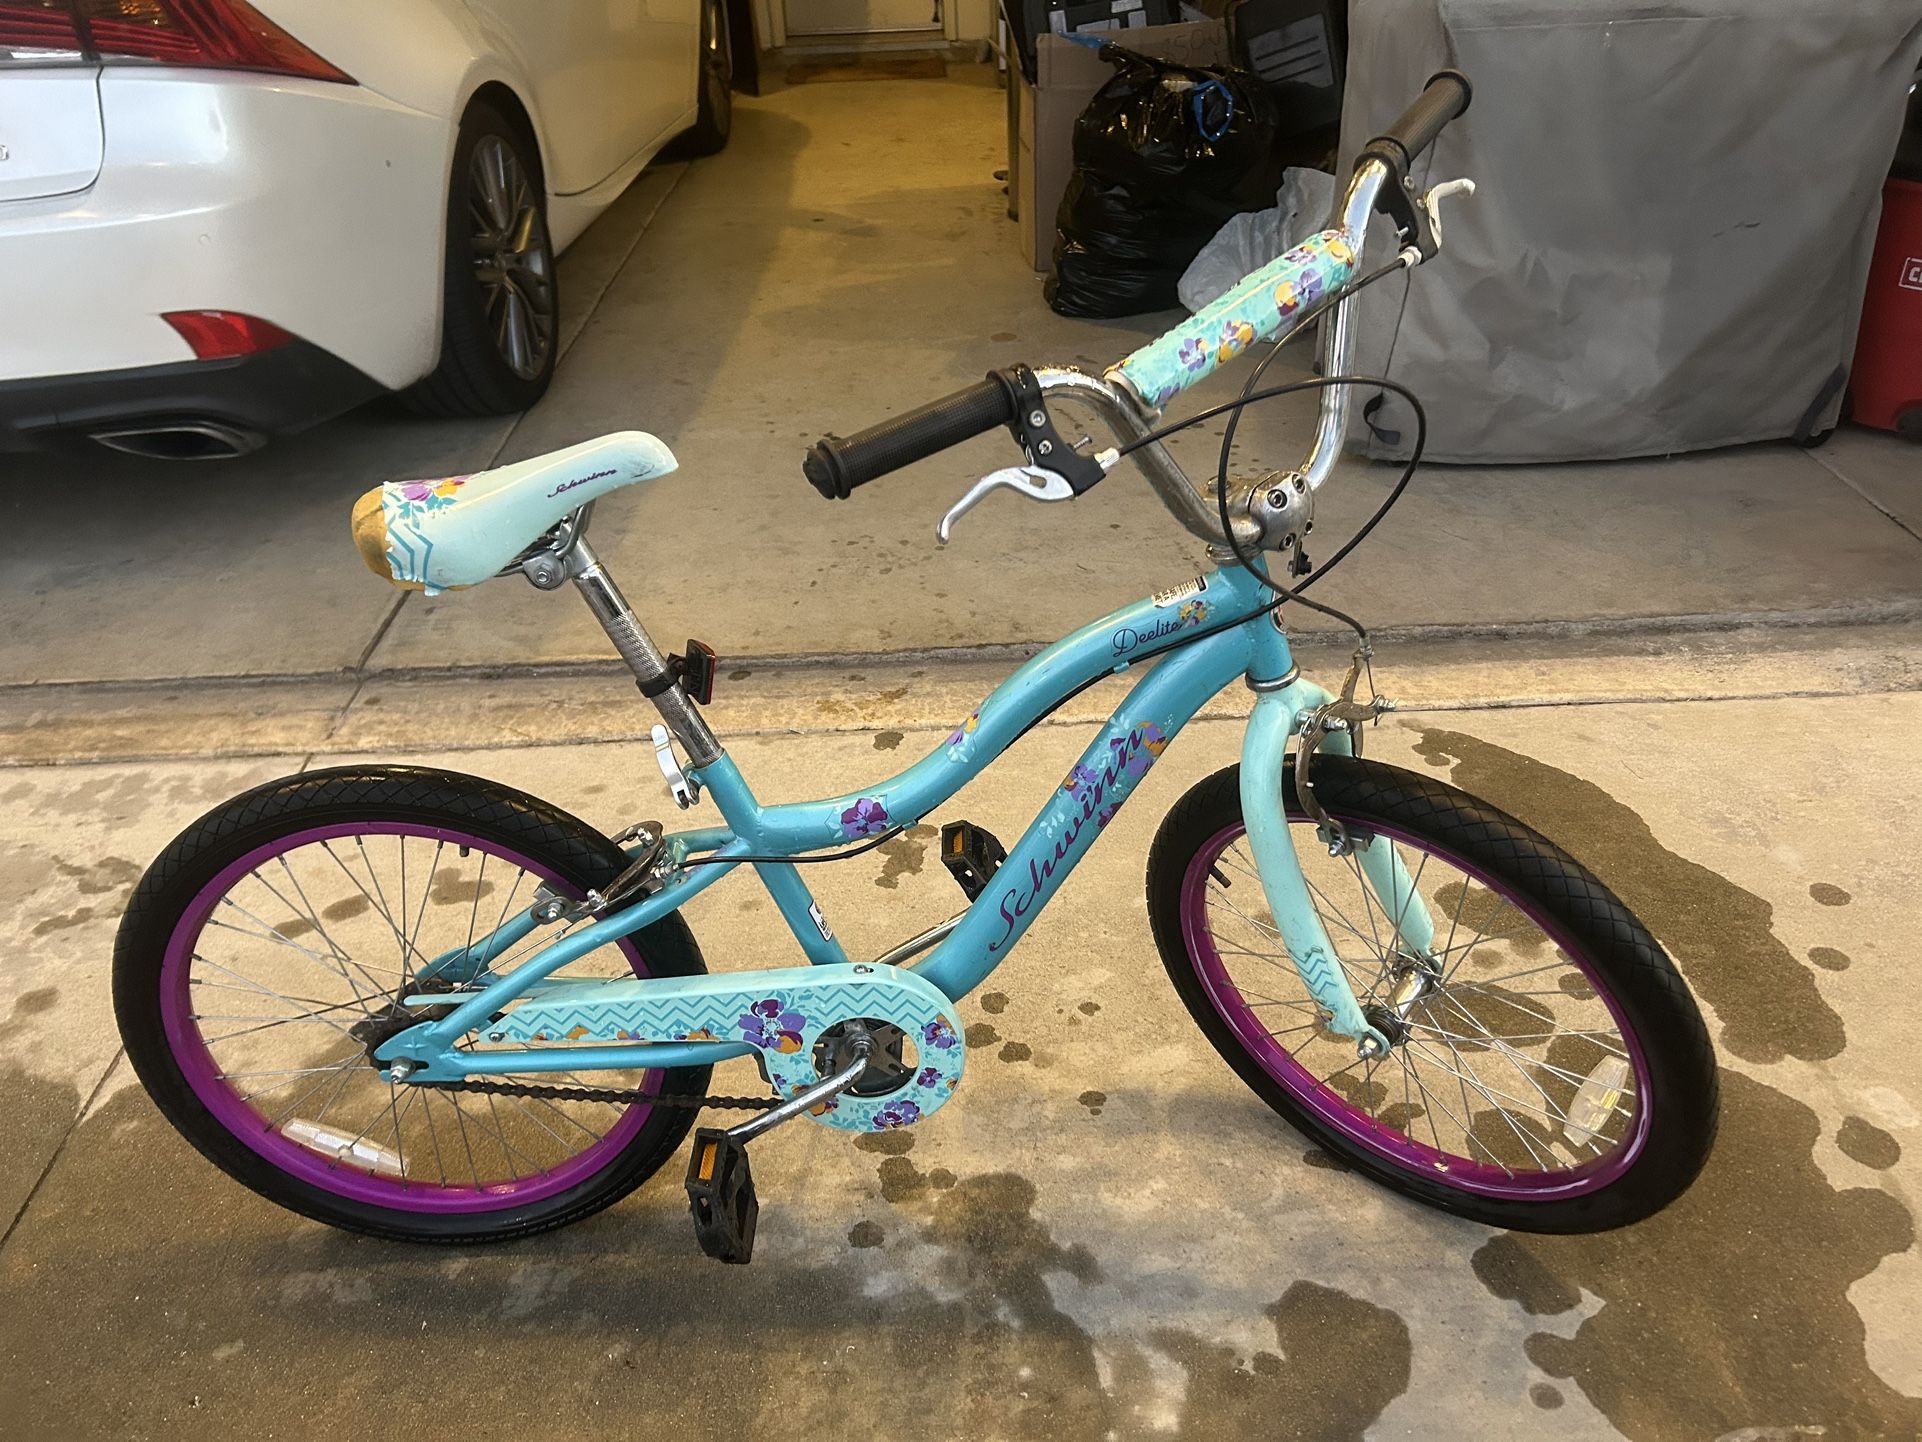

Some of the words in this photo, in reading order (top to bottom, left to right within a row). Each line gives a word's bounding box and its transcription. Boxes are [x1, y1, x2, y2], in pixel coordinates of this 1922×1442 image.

[547, 469, 618, 498] Schwinn
[1112, 619, 1184, 658] Deelite
[988, 728, 1144, 952] Schwinn
